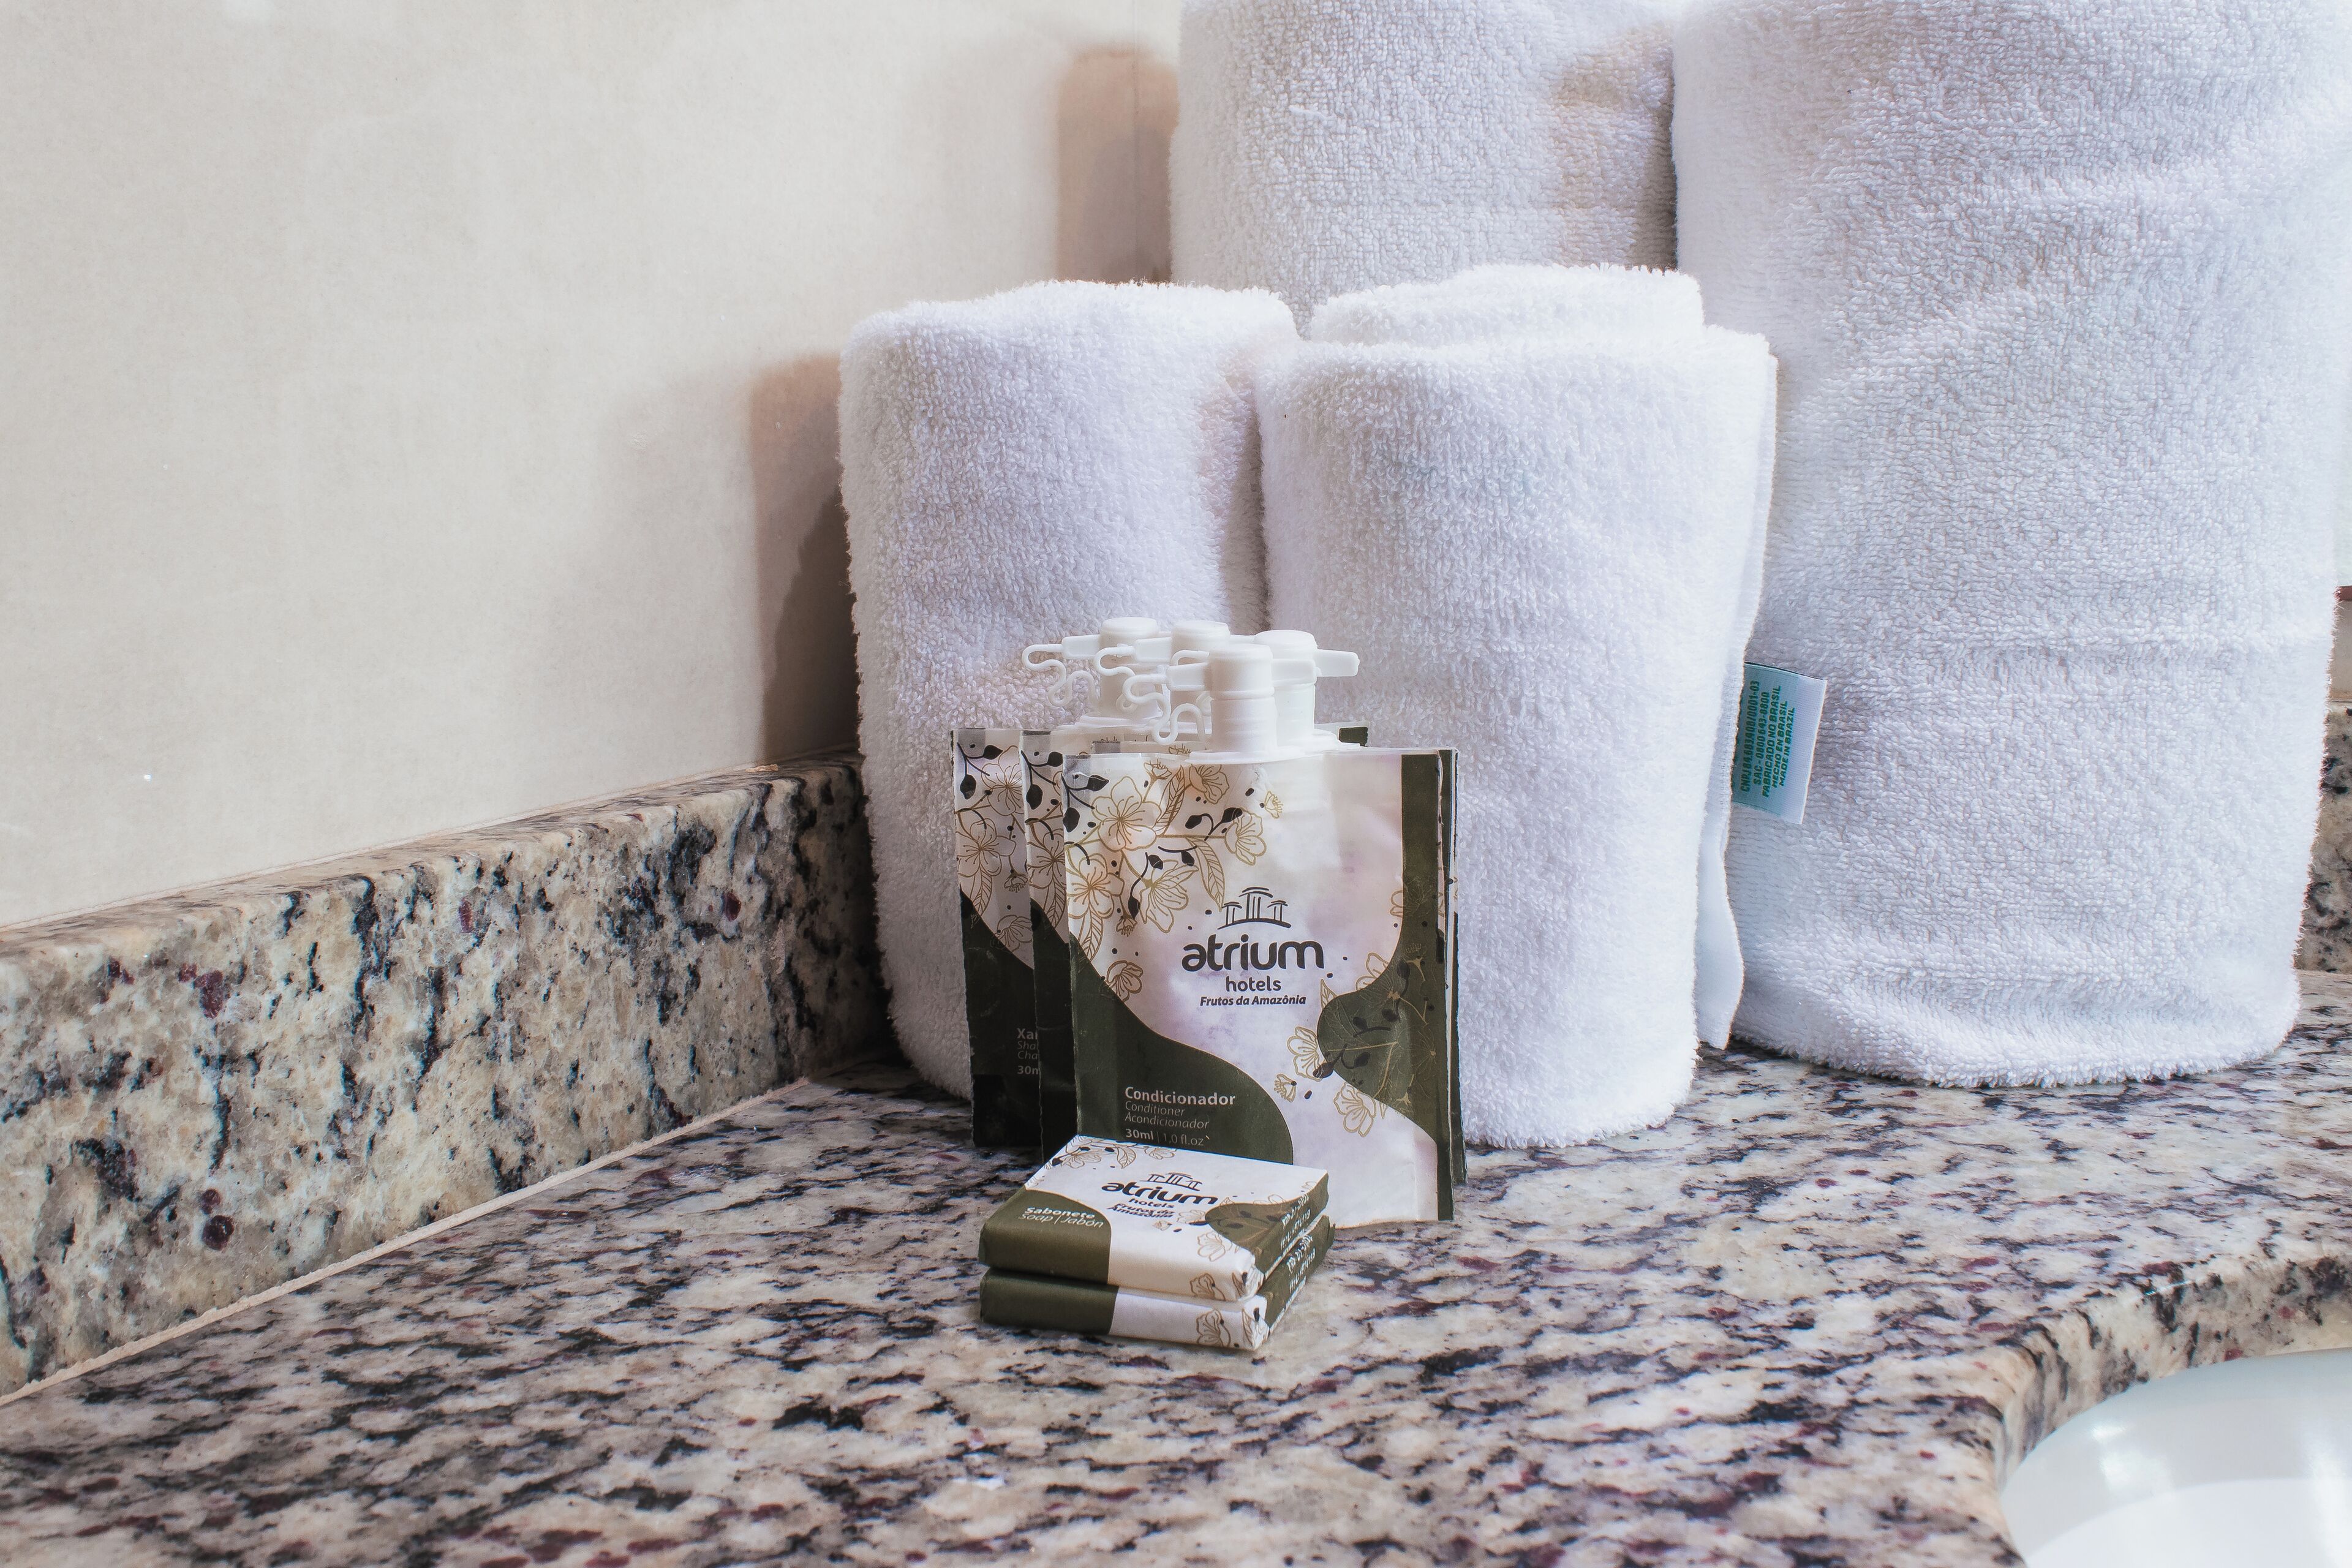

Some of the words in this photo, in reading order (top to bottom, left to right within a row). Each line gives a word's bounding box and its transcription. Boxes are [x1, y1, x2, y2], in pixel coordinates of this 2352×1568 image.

[1769, 685, 1781, 723] BRASIL
[1777, 701, 1787, 737] BRASIL
[1784, 707, 1795, 745] BRAZIL
[1768, 724, 1776, 738] NO
[1755, 736, 1765, 759] 0800
[1775, 739, 1784, 752] EN
[1784, 745, 1790, 756] IN
[1754, 766, 1762, 785] SAC
[1762, 740, 1774, 797] FABRICADO
[1771, 753, 1781, 788] HECHO
[1779, 757, 1789, 786] MADE
[1740, 769, 1751, 792] CNPJ
[1182, 933, 1325, 972] atrium
[1226, 975, 1281, 992] hotels
[1200, 995, 1234, 1006] Frutos
[1236, 996, 1250, 1005] da
[1251, 995, 1306, 1005] Amazônia
[1125, 1087, 1236, 1106] Condicionador
[1125, 1101, 1185, 1117] Conditioner
[1125, 1112, 1209, 1129] Acondicionador
[1126, 1128, 1154, 1140] 30ml
[1164, 1133, 1178, 1144] 1,0
[1101, 1182, 1219, 1205] atrium
[1114, 1203, 1155, 1213] Frutos
[1128, 1198, 1175, 1208] hotels
[1018, 1213, 1054, 1223] Soap
[1025, 1207, 1095, 1219] Sabonete
[1107, 1206, 1174, 1218] Amazônia
